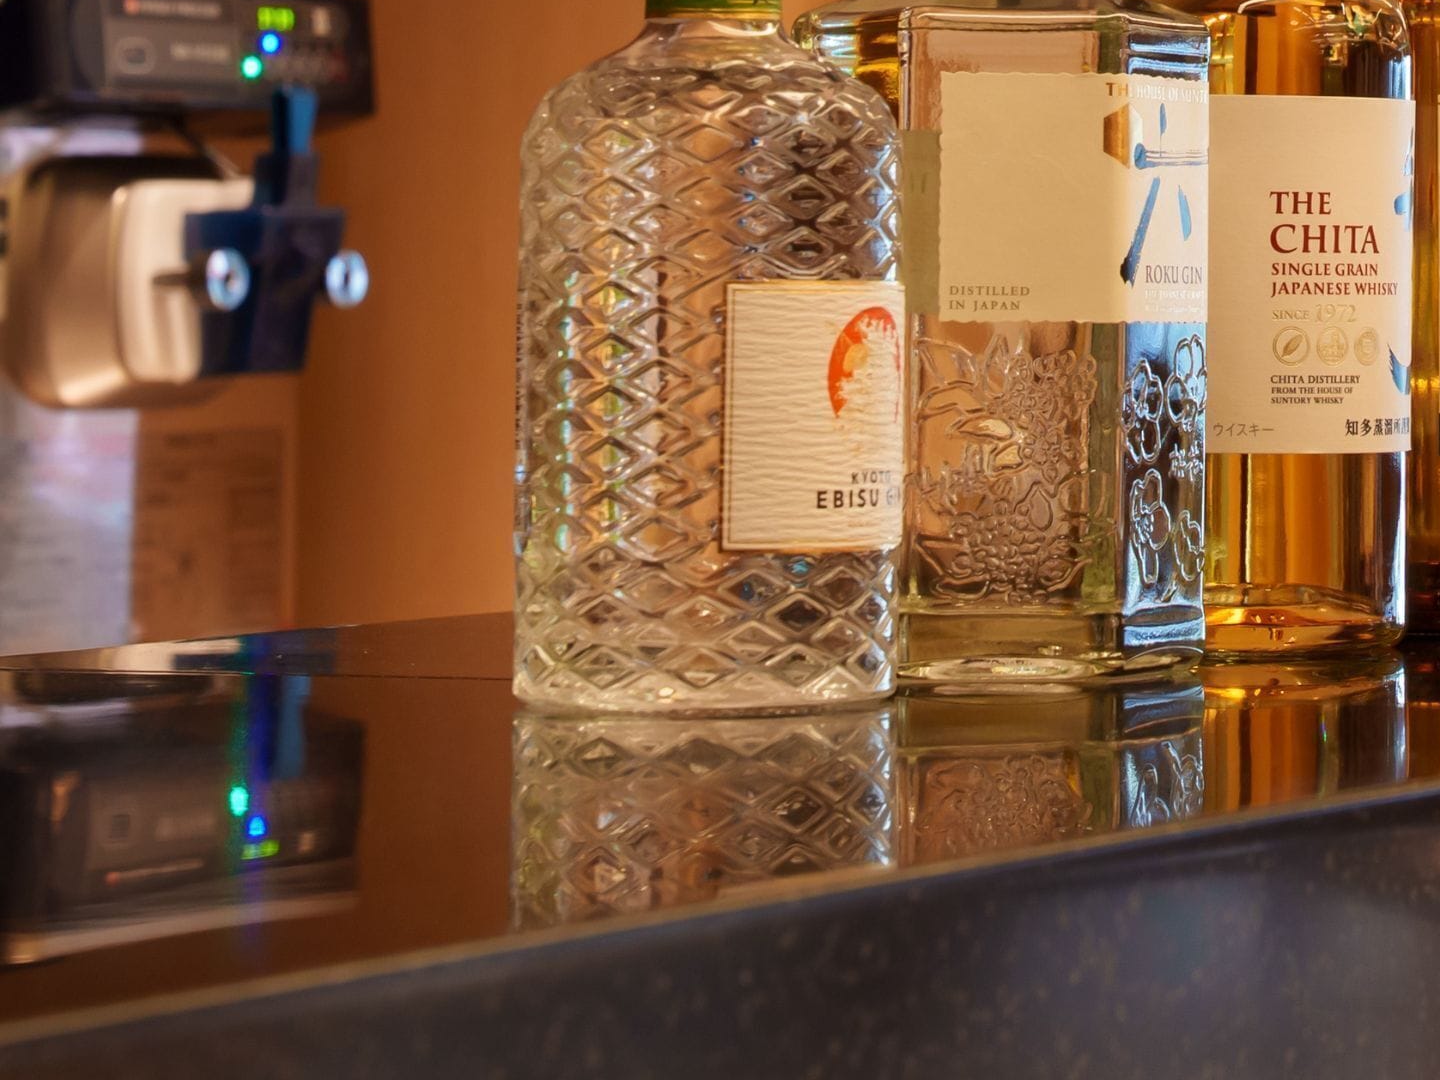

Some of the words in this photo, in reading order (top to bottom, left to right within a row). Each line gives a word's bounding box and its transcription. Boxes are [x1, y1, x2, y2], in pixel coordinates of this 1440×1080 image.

[1269, 191, 1332, 215] THE
[1270, 224, 1380, 254] CHITA
[1145, 264, 1179, 284] ROKU
[1181, 266, 1203, 285] GIN
[1271, 263, 1331, 276] SINGLE
[1334, 263, 1379, 277] GRAIN
[949, 285, 1031, 297] DISTILLED
[1270, 282, 1351, 298] JAPANESE
[1354, 283, 1399, 296] WHISKY
[949, 300, 966, 311] IN
[973, 300, 1022, 312] JAPAN
[1271, 309, 1311, 321] SINCE
[1315, 303, 1357, 323] 1972
[1270, 375, 1305, 384] CHITA
[1308, 375, 1361, 384] DISTILLERY
[1271, 387, 1297, 395] FROM
[1299, 387, 1315, 395] THE
[1317, 387, 1342, 395] HOUSE
[1344, 387, 1353, 395] OF
[1271, 397, 1312, 405] SUNTORY
[1314, 397, 1344, 405] WHISKY
[1213, 423, 1275, 437] ウイスキー
[851, 470, 891, 484] KYOTO
[816, 488, 879, 509] EBISU
